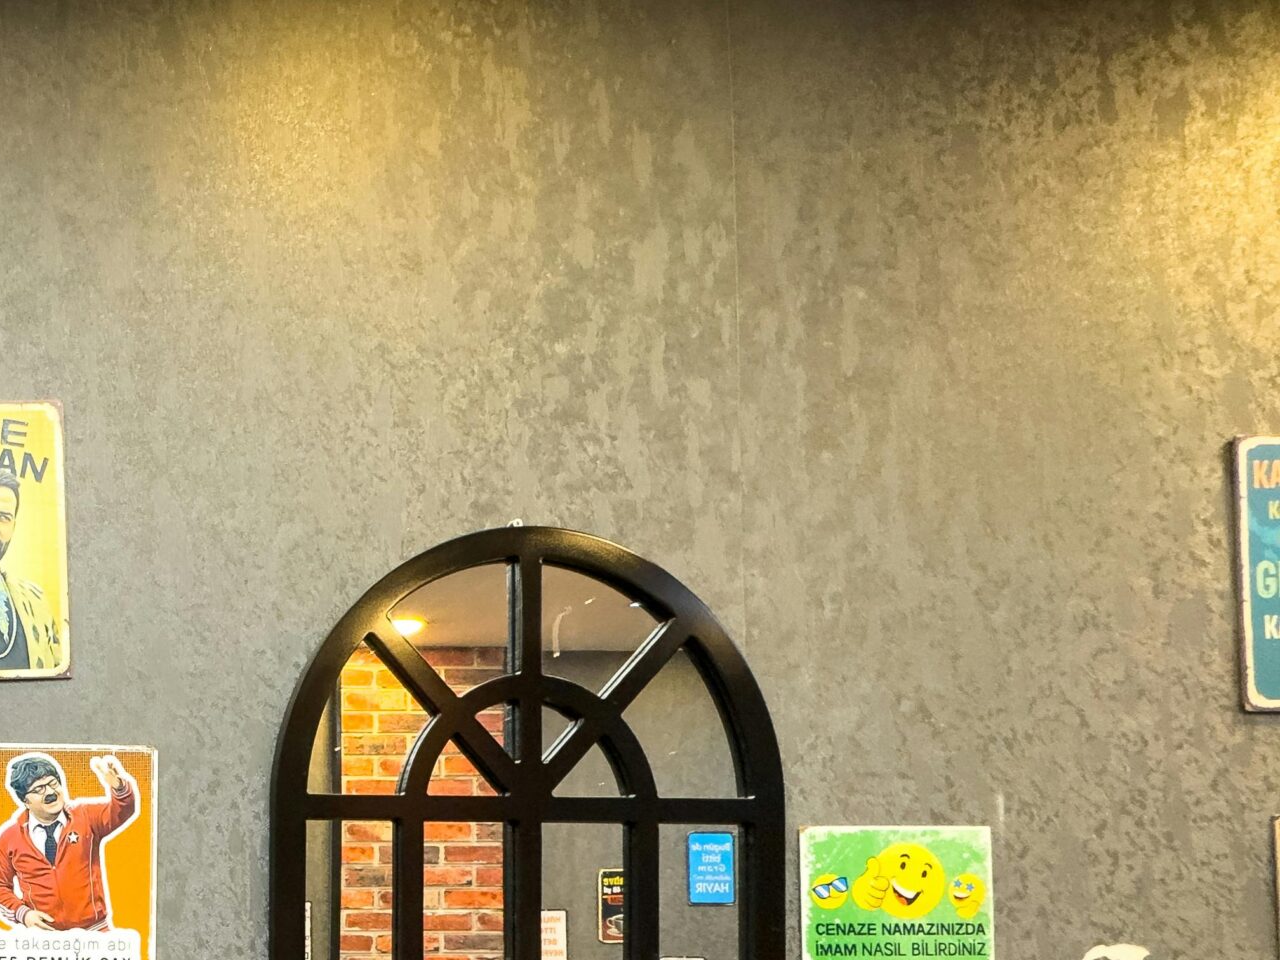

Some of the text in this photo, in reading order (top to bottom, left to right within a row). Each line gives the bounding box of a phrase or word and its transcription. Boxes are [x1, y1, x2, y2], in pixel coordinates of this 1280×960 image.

[816, 923, 985, 936] CENAZE NAMAZINIZDA
[816, 939, 986, 957] İMAM NASIL BİLİRDİNİZ
